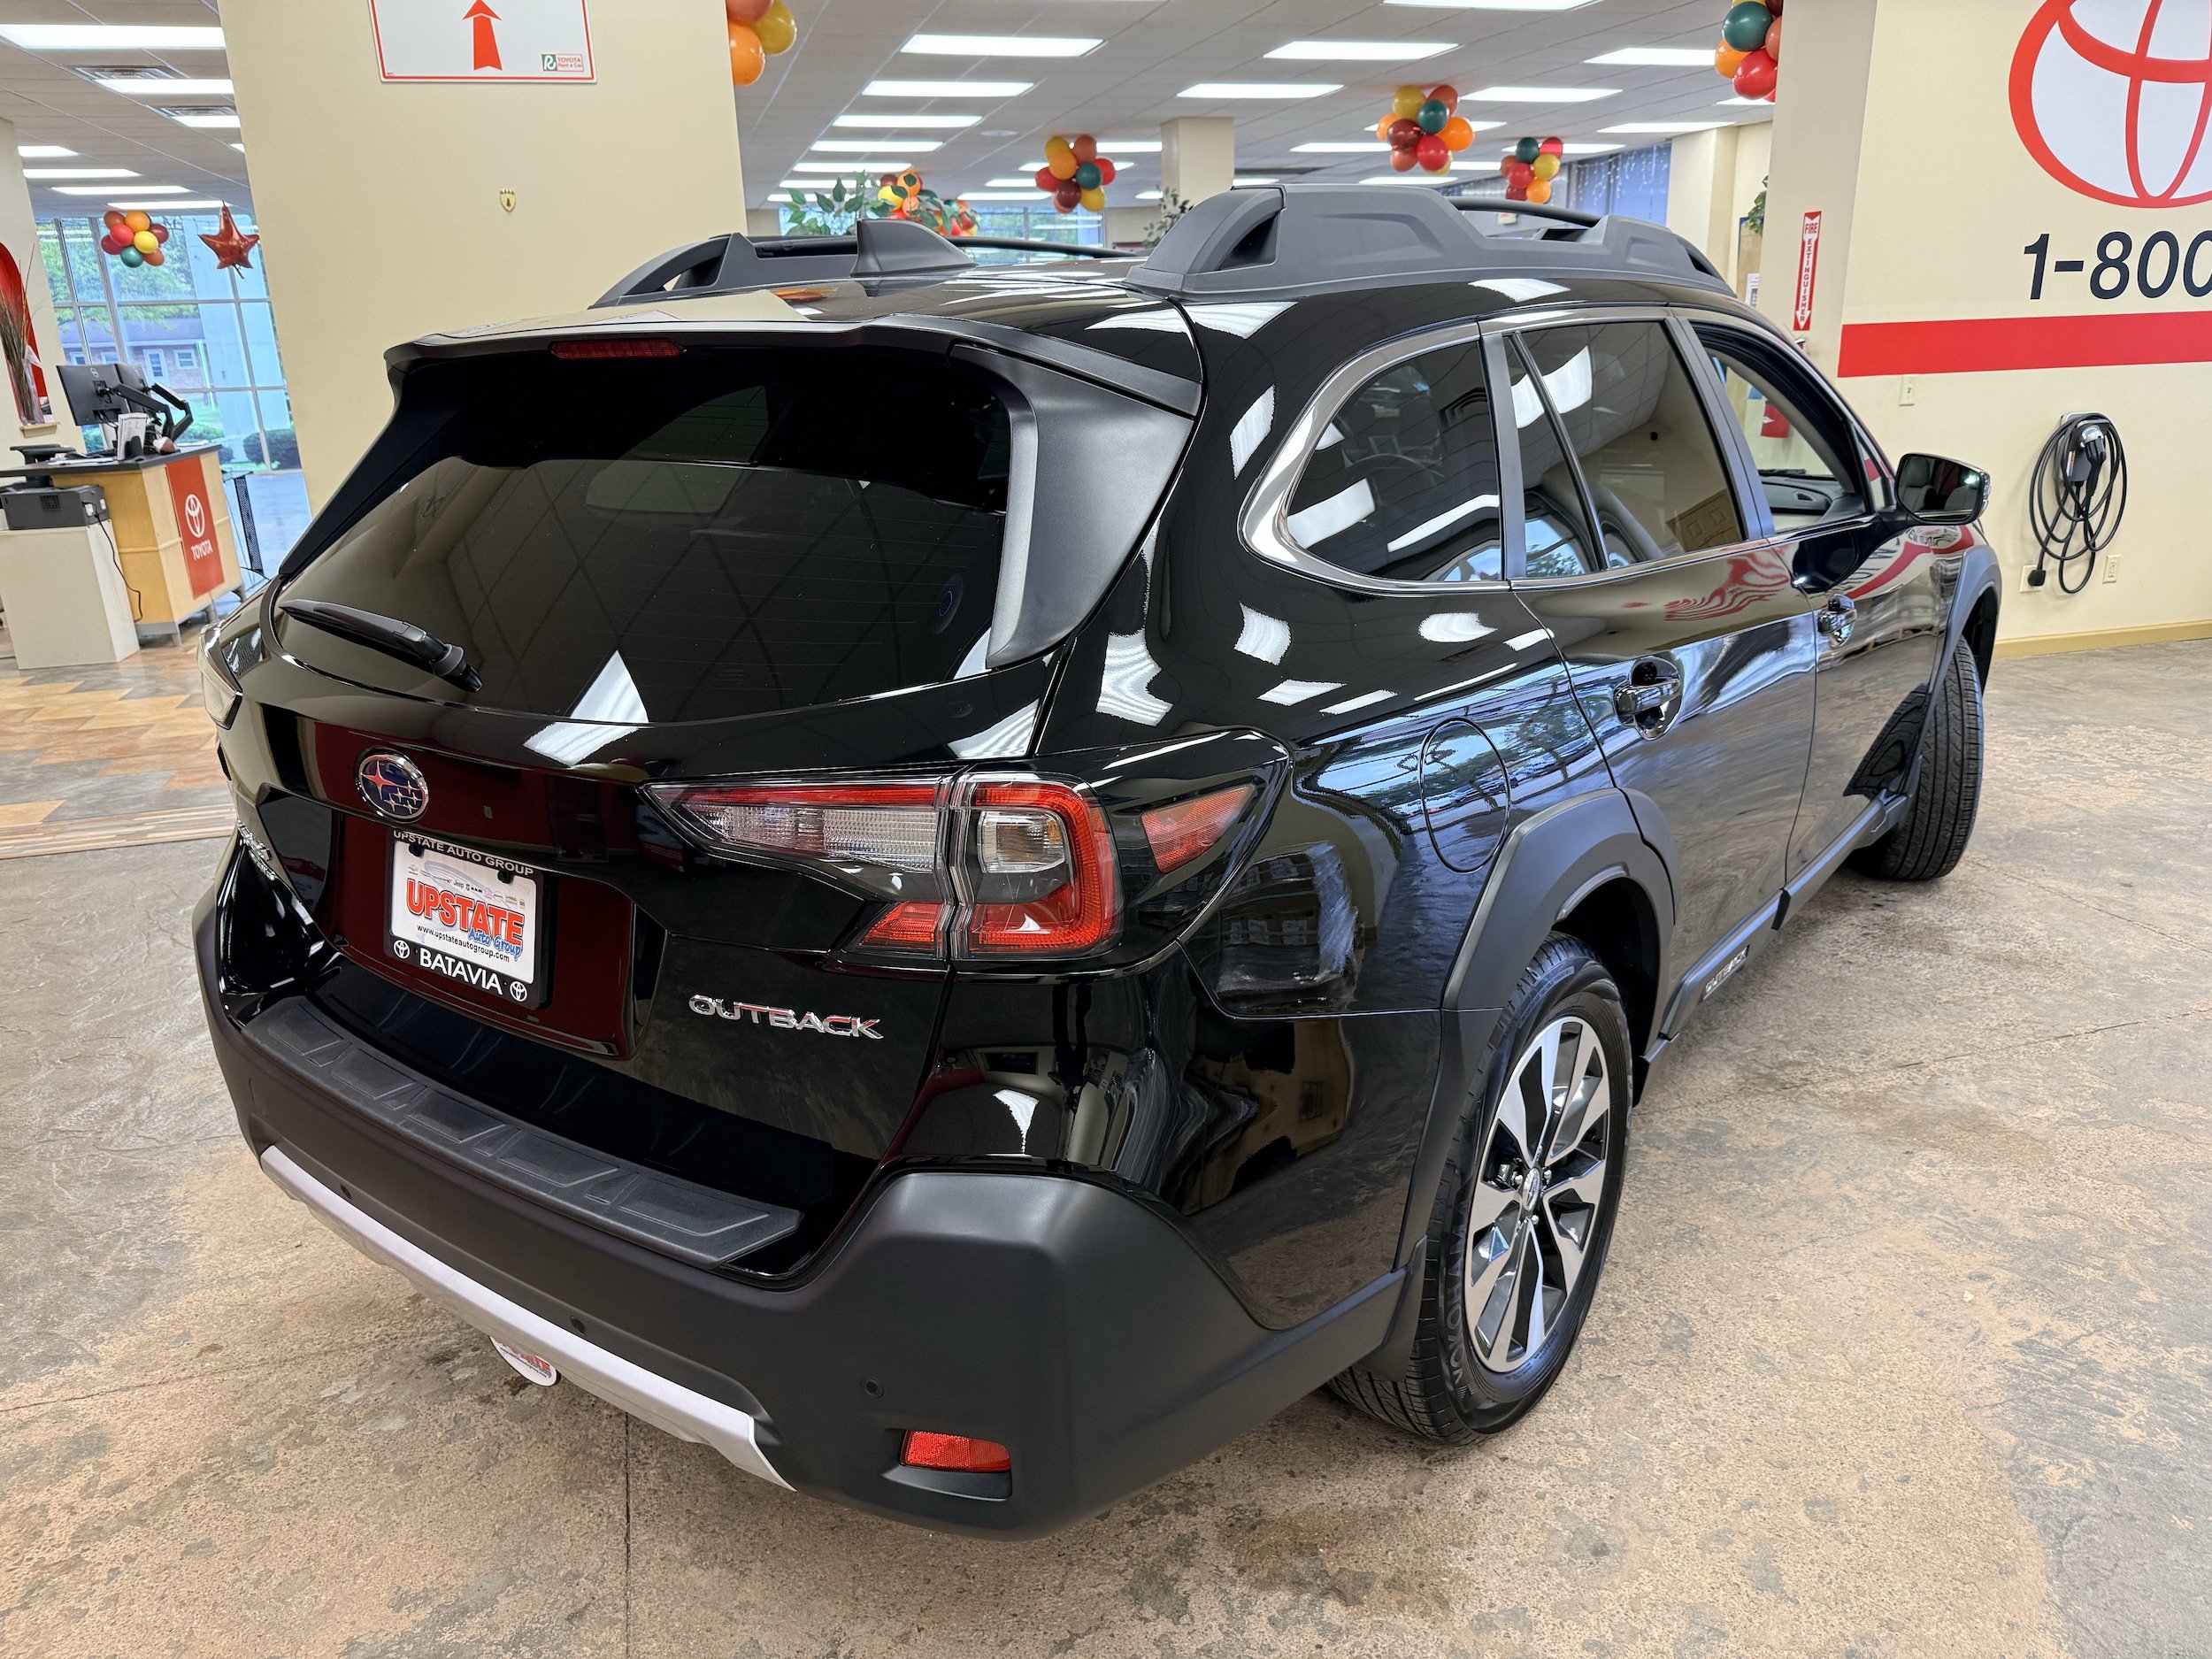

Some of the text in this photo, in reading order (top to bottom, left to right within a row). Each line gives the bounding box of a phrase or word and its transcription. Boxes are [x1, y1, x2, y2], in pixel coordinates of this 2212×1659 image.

[1805, 223, 1817, 234] FIRE
[1800, 238, 1812, 322] EXTINGUISHER
[2024, 230, 2212, 300] 1-800
[191, 539, 213, 560] TOYOTA
[393, 830, 534, 875] UPSTATE AUTO GROUP
[407, 878, 525, 946] UPSTATE
[417, 925, 510, 962] www.upstateautogroup.com
[468, 927, 524, 958] Auto Group
[419, 948, 503, 995] BATAVIA
[688, 995, 884, 1039] OUTBACK
[1446, 1198, 1469, 1385] YOKOHAMA
